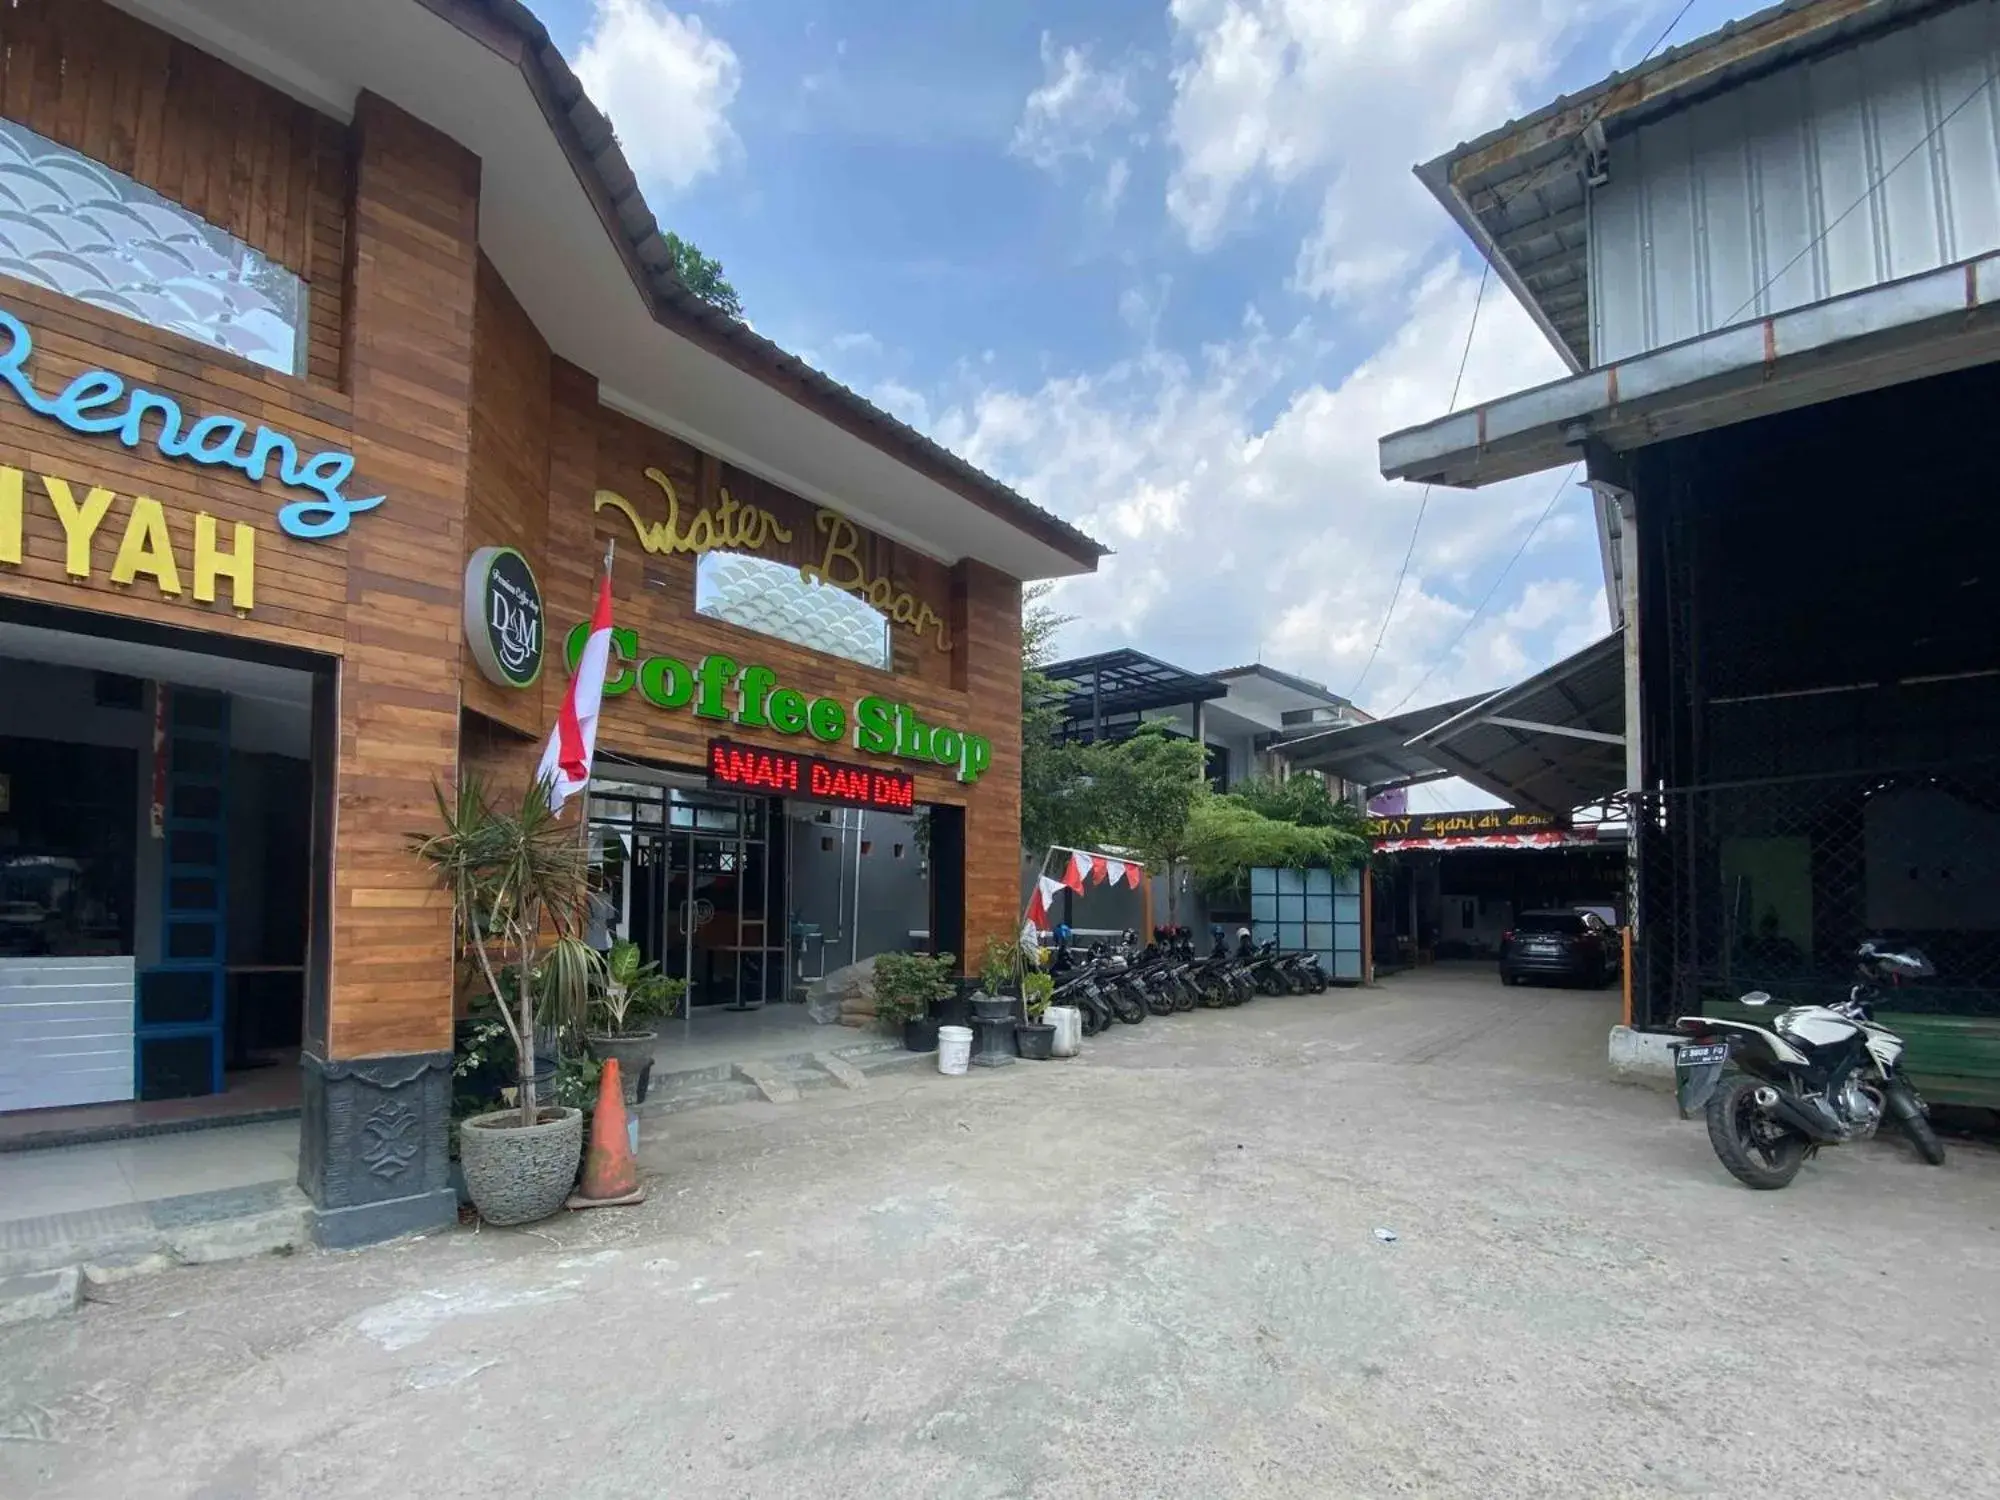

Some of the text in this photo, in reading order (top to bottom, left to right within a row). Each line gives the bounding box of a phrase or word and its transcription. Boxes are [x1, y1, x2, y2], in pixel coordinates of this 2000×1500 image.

[594, 467, 792, 555] Water
[563, 621, 992, 784] Coffee Shop
[811, 763, 869, 801] DAN
[873, 775, 913, 808] DM
